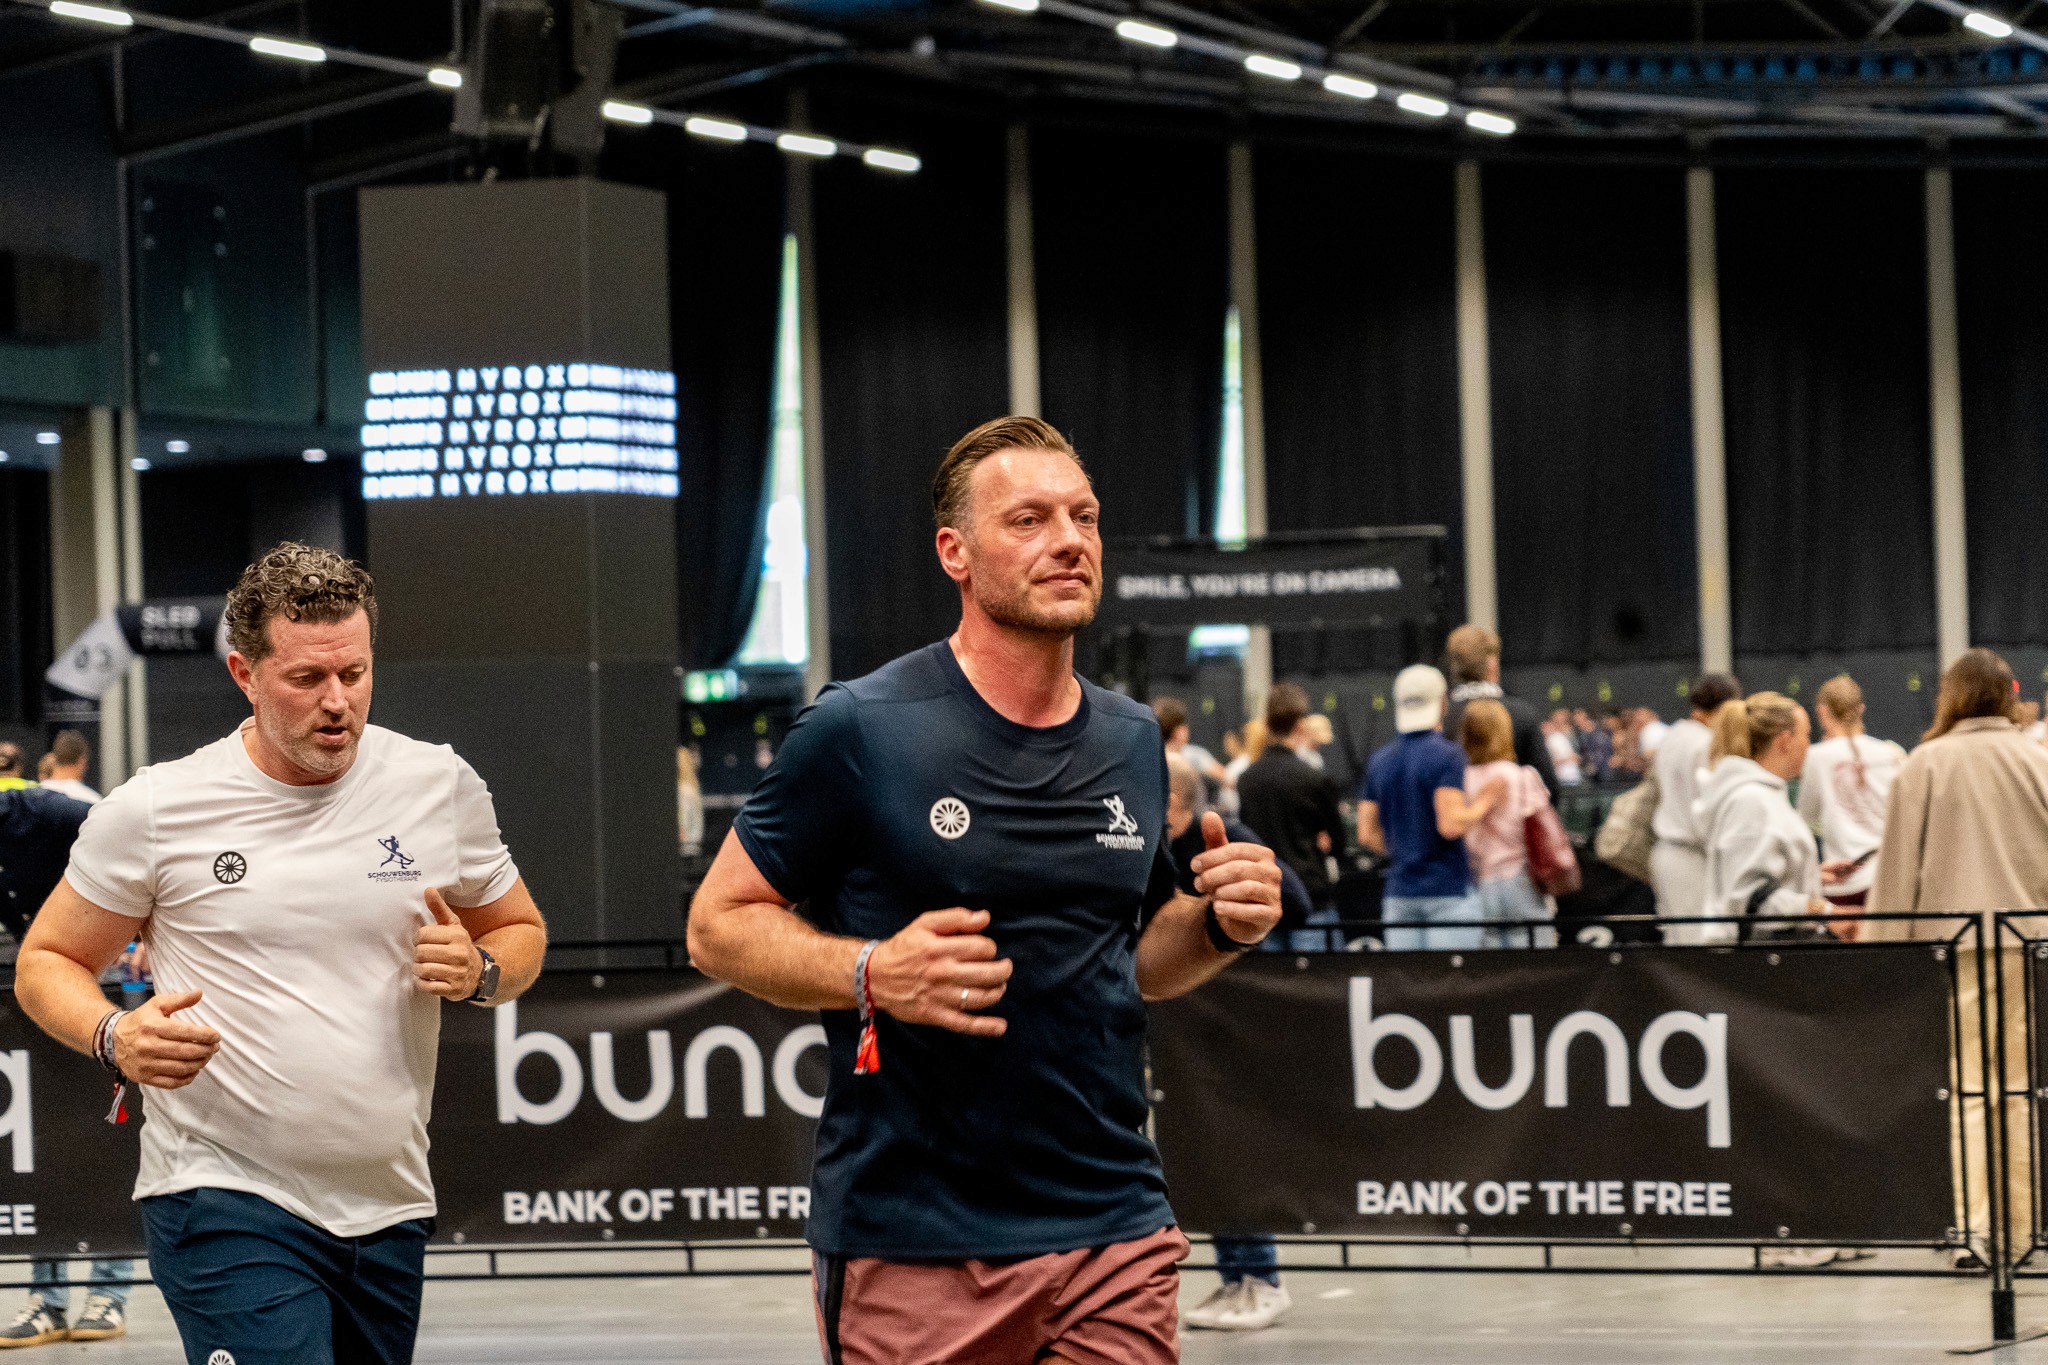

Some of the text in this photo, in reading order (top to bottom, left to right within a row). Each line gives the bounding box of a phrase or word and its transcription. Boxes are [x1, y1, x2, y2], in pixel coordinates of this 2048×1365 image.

[457, 364, 566, 392] HYROX
[453, 390, 561, 418] HYROX
[449, 416, 557, 445] HYROX
[444, 442, 553, 471] HYROX
[439, 469, 549, 497] HYROX
[1349, 976, 1731, 1148] bunq
[503, 1186, 811, 1224] BANK OF THE FR
[1356, 1181, 1732, 1216] BANK OF THE FREE
